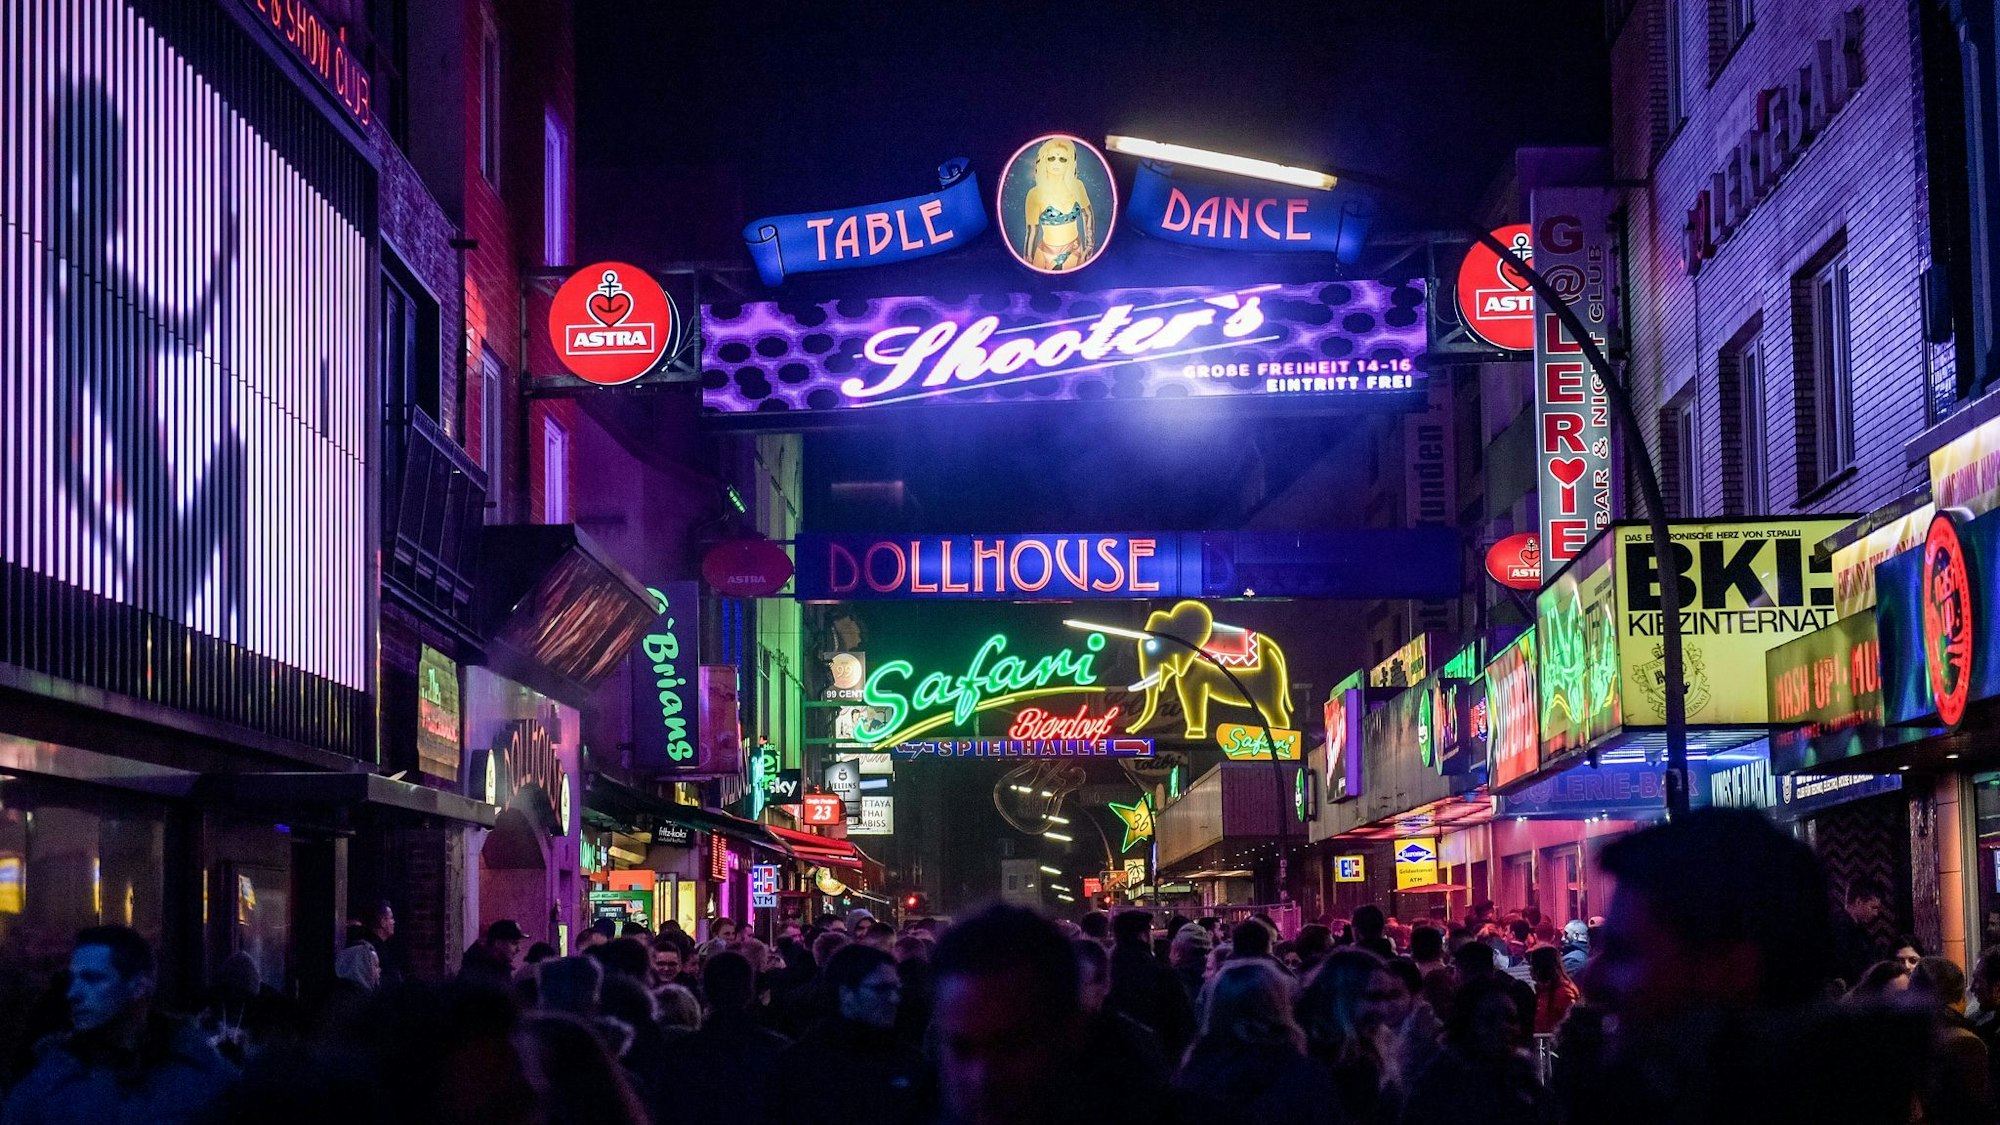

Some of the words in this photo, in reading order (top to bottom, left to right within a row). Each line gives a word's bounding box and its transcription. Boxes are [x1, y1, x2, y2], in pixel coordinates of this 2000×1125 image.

[335, 47, 369, 126] CLUB
[807, 199, 954, 261] TABLE
[1161, 187, 1311, 240] DANCE
[1587, 246, 1605, 324] CLUB
[573, 331, 647, 347] ASTRA
[842, 294, 1265, 397] Shooter's
[1257, 359, 1350, 376] FREIHEIT
[1356, 358, 1413, 373] 14-16
[1266, 376, 1360, 393] EINTRITT
[1366, 374, 1413, 390] FREI
[1589, 331, 1608, 427] NIGT
[1593, 469, 1611, 531] BAR
[1625, 534, 1642, 542] DAS
[1646, 532, 1713, 542] ELRONISCHE
[1716, 531, 1740, 540] HERZ
[1742, 530, 1764, 539] VON
[831, 538, 1160, 593] DOLLHOUSE
[727, 575, 766, 584] ASTRA
[826, 690, 837, 698] 99
[839, 690, 865, 698] CENT
[854, 633, 1107, 743] Safari
[1008, 704, 1119, 746] Bierdorf
[937, 739, 1108, 757] SPIELHALLE
[769, 776, 798, 797] sky
[813, 805, 831, 821] 23
[1131, 813, 1149, 833] 36
